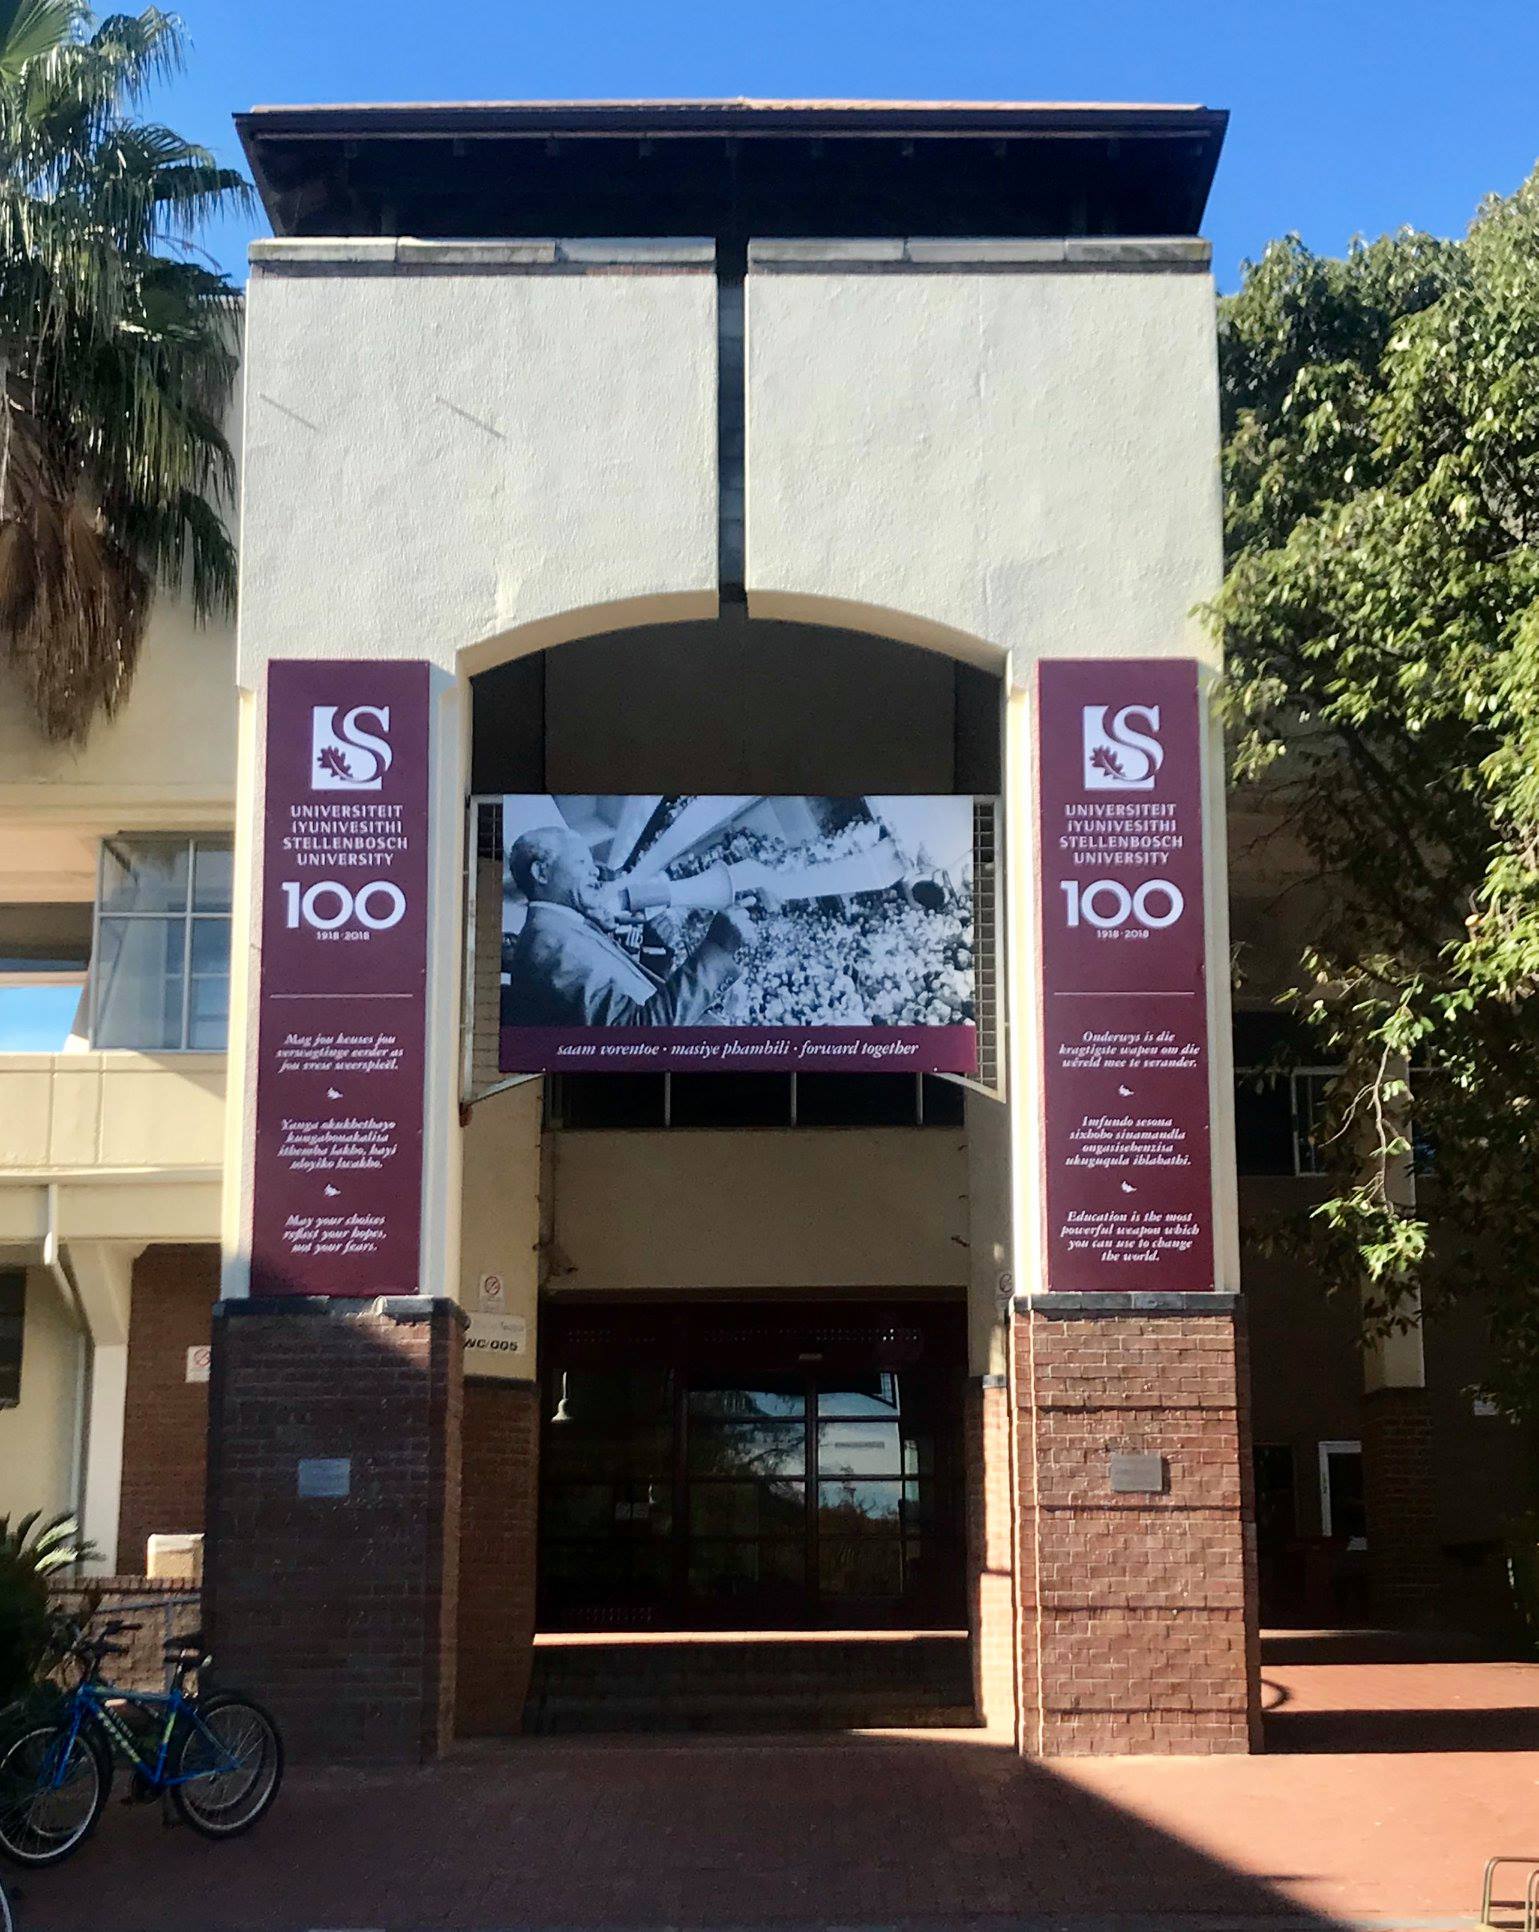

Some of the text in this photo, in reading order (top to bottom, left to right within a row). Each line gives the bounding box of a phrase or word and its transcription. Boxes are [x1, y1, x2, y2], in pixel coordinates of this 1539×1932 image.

[290, 805, 403, 818] UNIVERSITEIT
[1065, 804, 1176, 817] UNIVERSITEIT
[283, 837, 408, 850] STELLENBOSCH
[1059, 835, 1183, 849] STELLENBOSCH
[297, 853, 393, 866] UNIVERSITY
[1074, 852, 1169, 865] UNIVERSITY
[282, 880, 406, 930] 100
[1060, 879, 1184, 928] 100
[284, 1034, 312, 1046] Mag
[314, 1033, 334, 1046] jou
[374, 1033, 396, 1049] jou
[1083, 1031, 1175, 1044] Onderwys is die
[557, 1040, 919, 1058] saam vorentoe masiye phambili forward together
[1059, 1044, 1200, 1057] kragtigste wapen om die
[278, 1060, 300, 1073] jou
[1130, 1058, 1140, 1067] te
[1143, 1057, 1197, 1068] verander.
[1082, 1116, 1133, 1128] Imfundo
[1116, 1129, 1186, 1140] sinamandla
[285, 1213, 385, 1228] May your choices
[1067, 1211, 1192, 1222] Education is the most
[282, 1227, 387, 1242] reflect your hopes,
[1060, 1224, 1199, 1237] powerful weapon which
[291, 1242, 312, 1253] not
[313, 1243, 343, 1255] your
[1068, 1238, 1192, 1251] you can use to change
[1101, 1251, 1159, 1261] the world.
